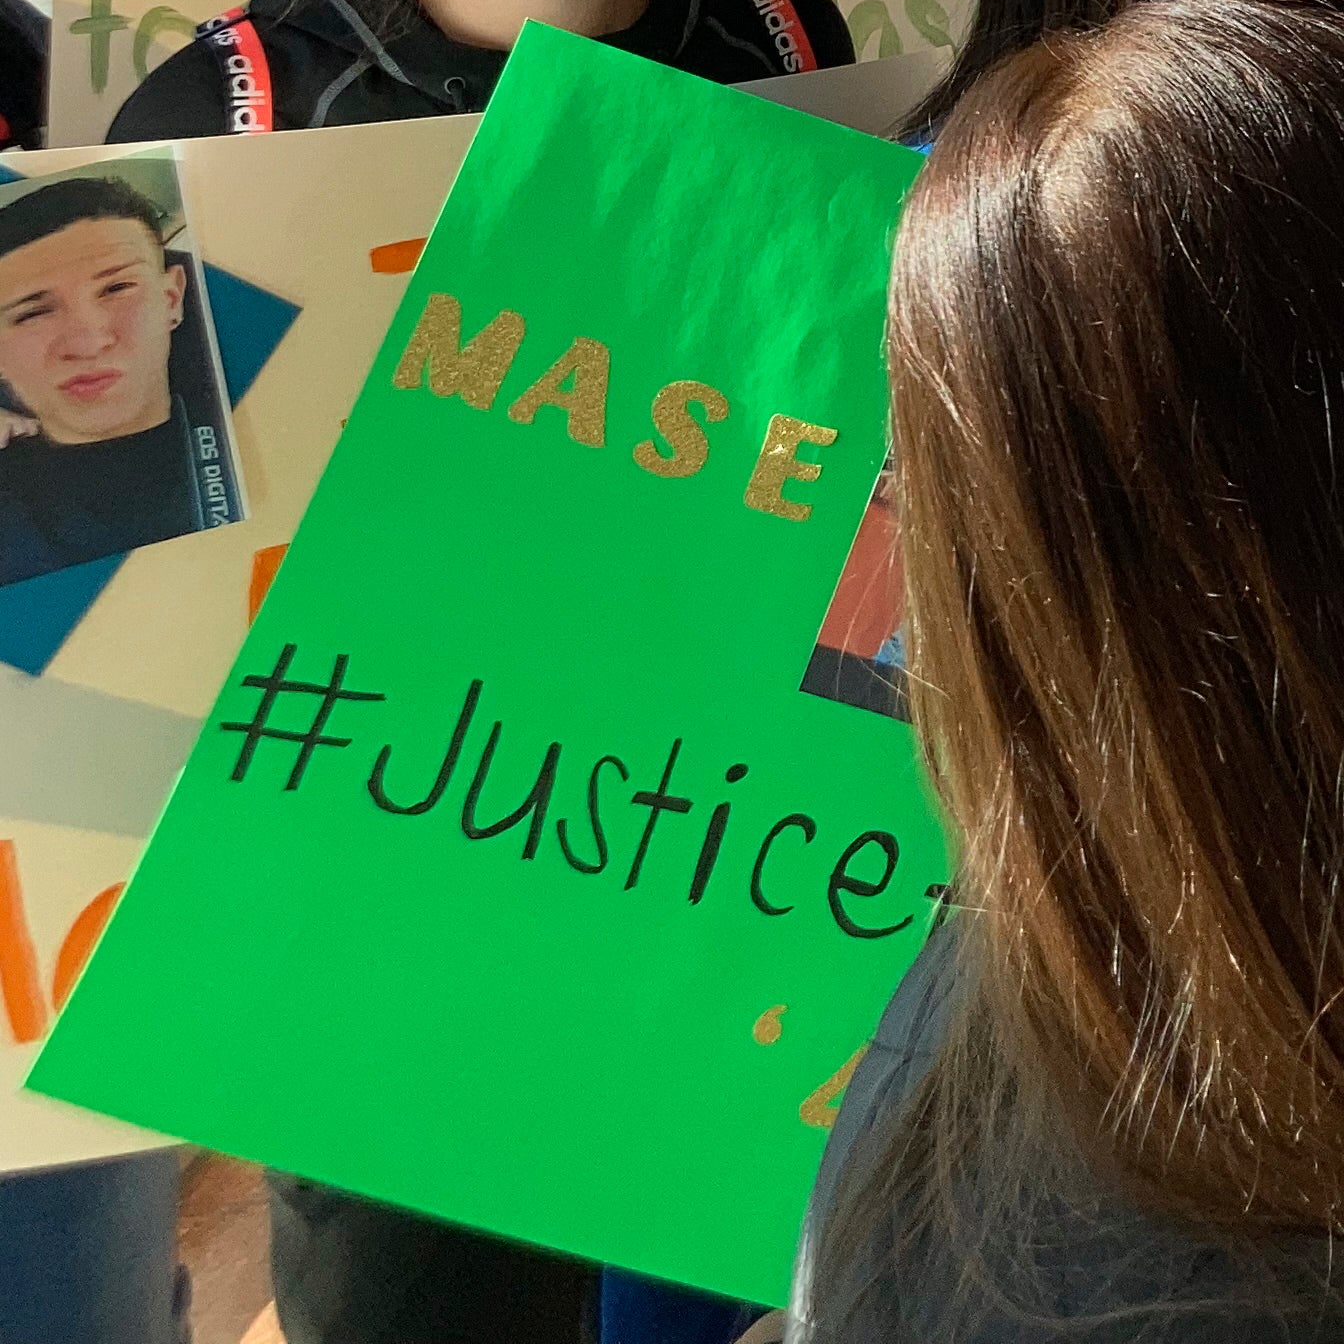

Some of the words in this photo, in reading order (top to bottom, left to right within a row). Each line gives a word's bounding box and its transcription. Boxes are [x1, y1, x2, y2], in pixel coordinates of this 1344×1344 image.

[226, 54, 266, 132] adid
[197, 426, 219, 461] EOS
[393, 292, 840, 522] MASE
[220, 643, 916, 939] #Justice
